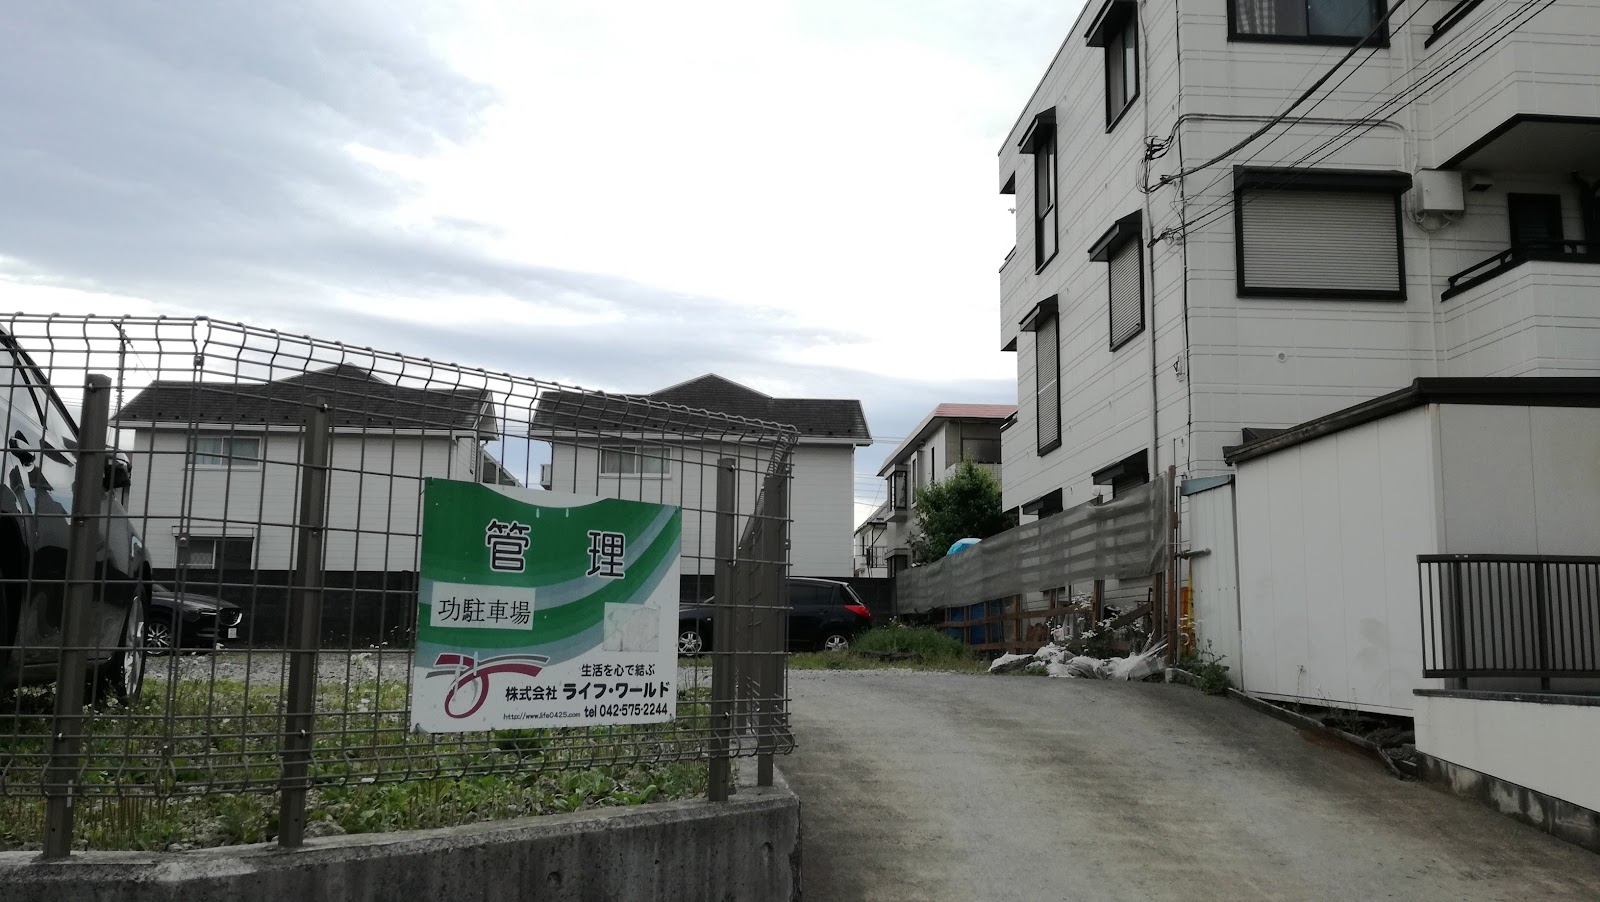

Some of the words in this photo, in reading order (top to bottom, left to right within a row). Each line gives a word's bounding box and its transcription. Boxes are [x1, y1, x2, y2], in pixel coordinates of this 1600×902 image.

[438, 597, 531, 624] 功駐車場
[581, 663, 655, 677] 生活を心で結ぶ
[505, 686, 557, 701] 株式会社
[563, 681, 670, 700] ライフ・ワールド
[584, 705, 597, 718] tel
